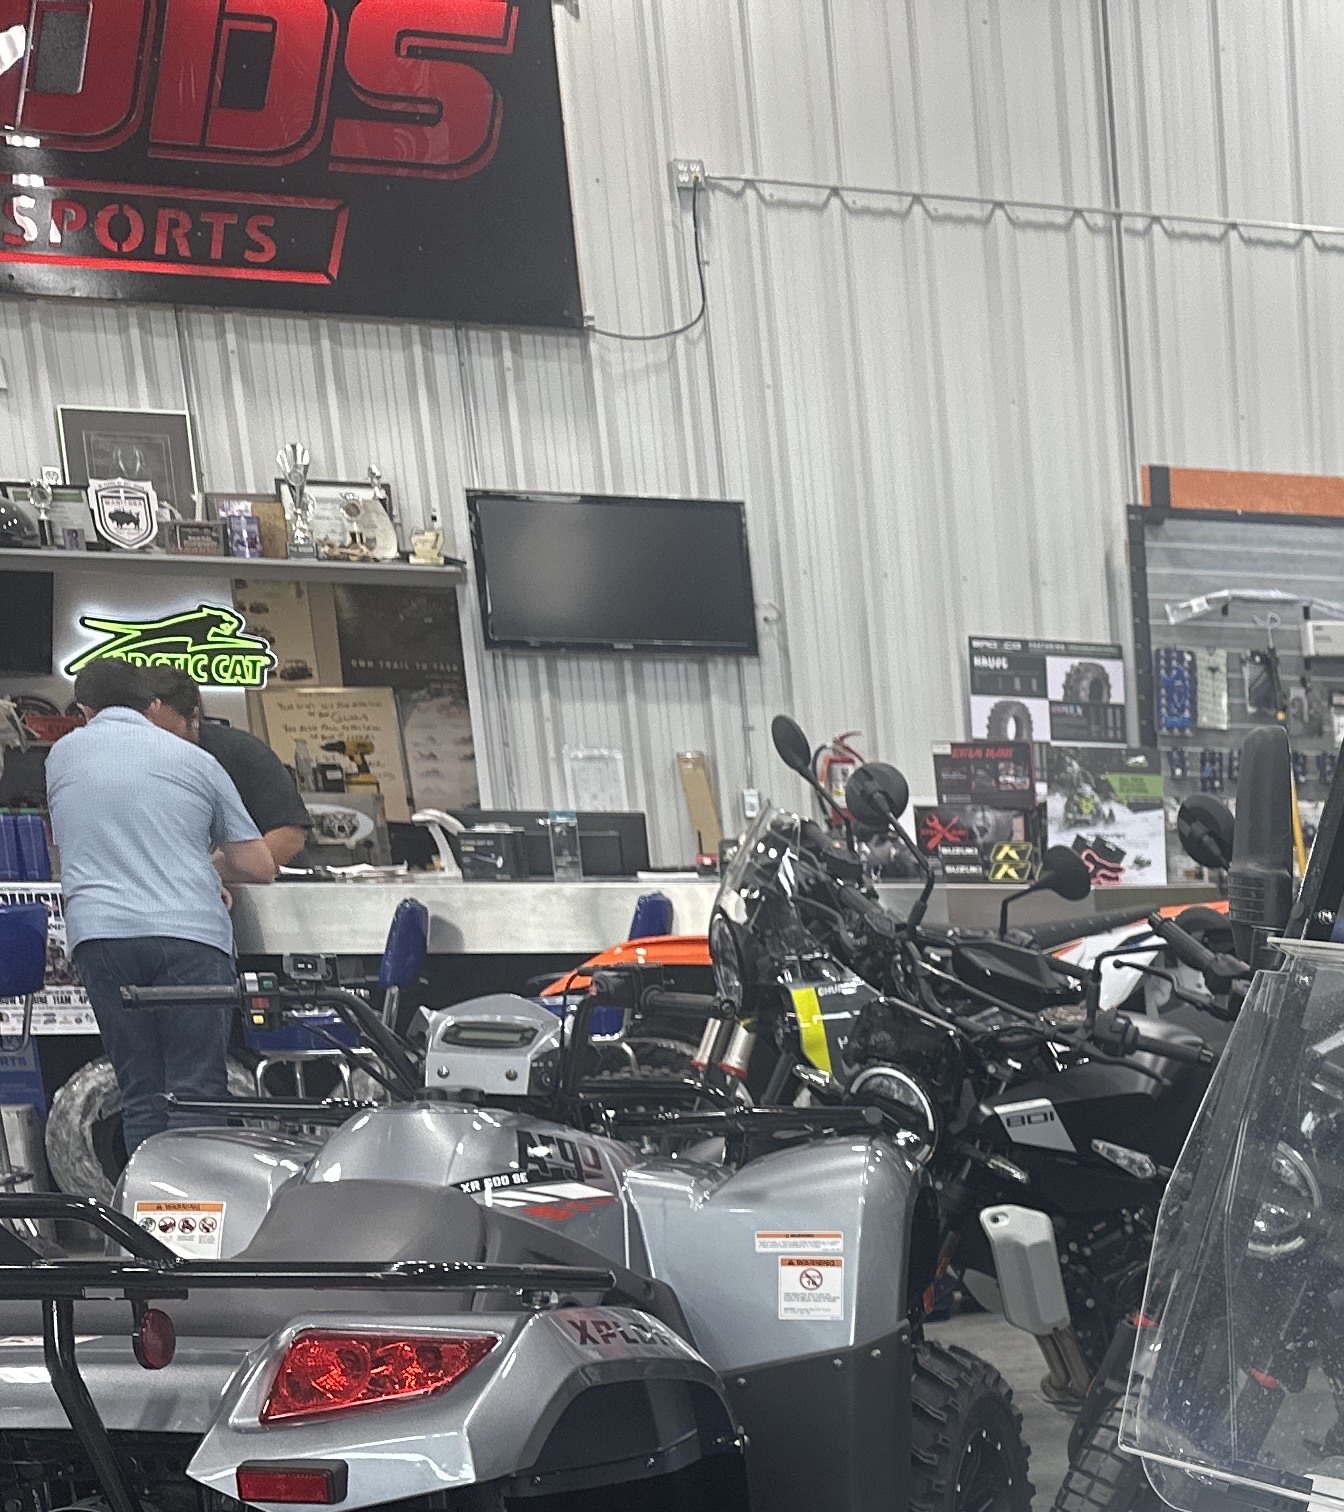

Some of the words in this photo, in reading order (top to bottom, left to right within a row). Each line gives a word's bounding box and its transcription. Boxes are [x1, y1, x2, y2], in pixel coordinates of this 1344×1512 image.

[2, 194, 277, 264] SPORTS
[211, 654, 271, 685] CAT
[460, 1180, 481, 1194] XR
